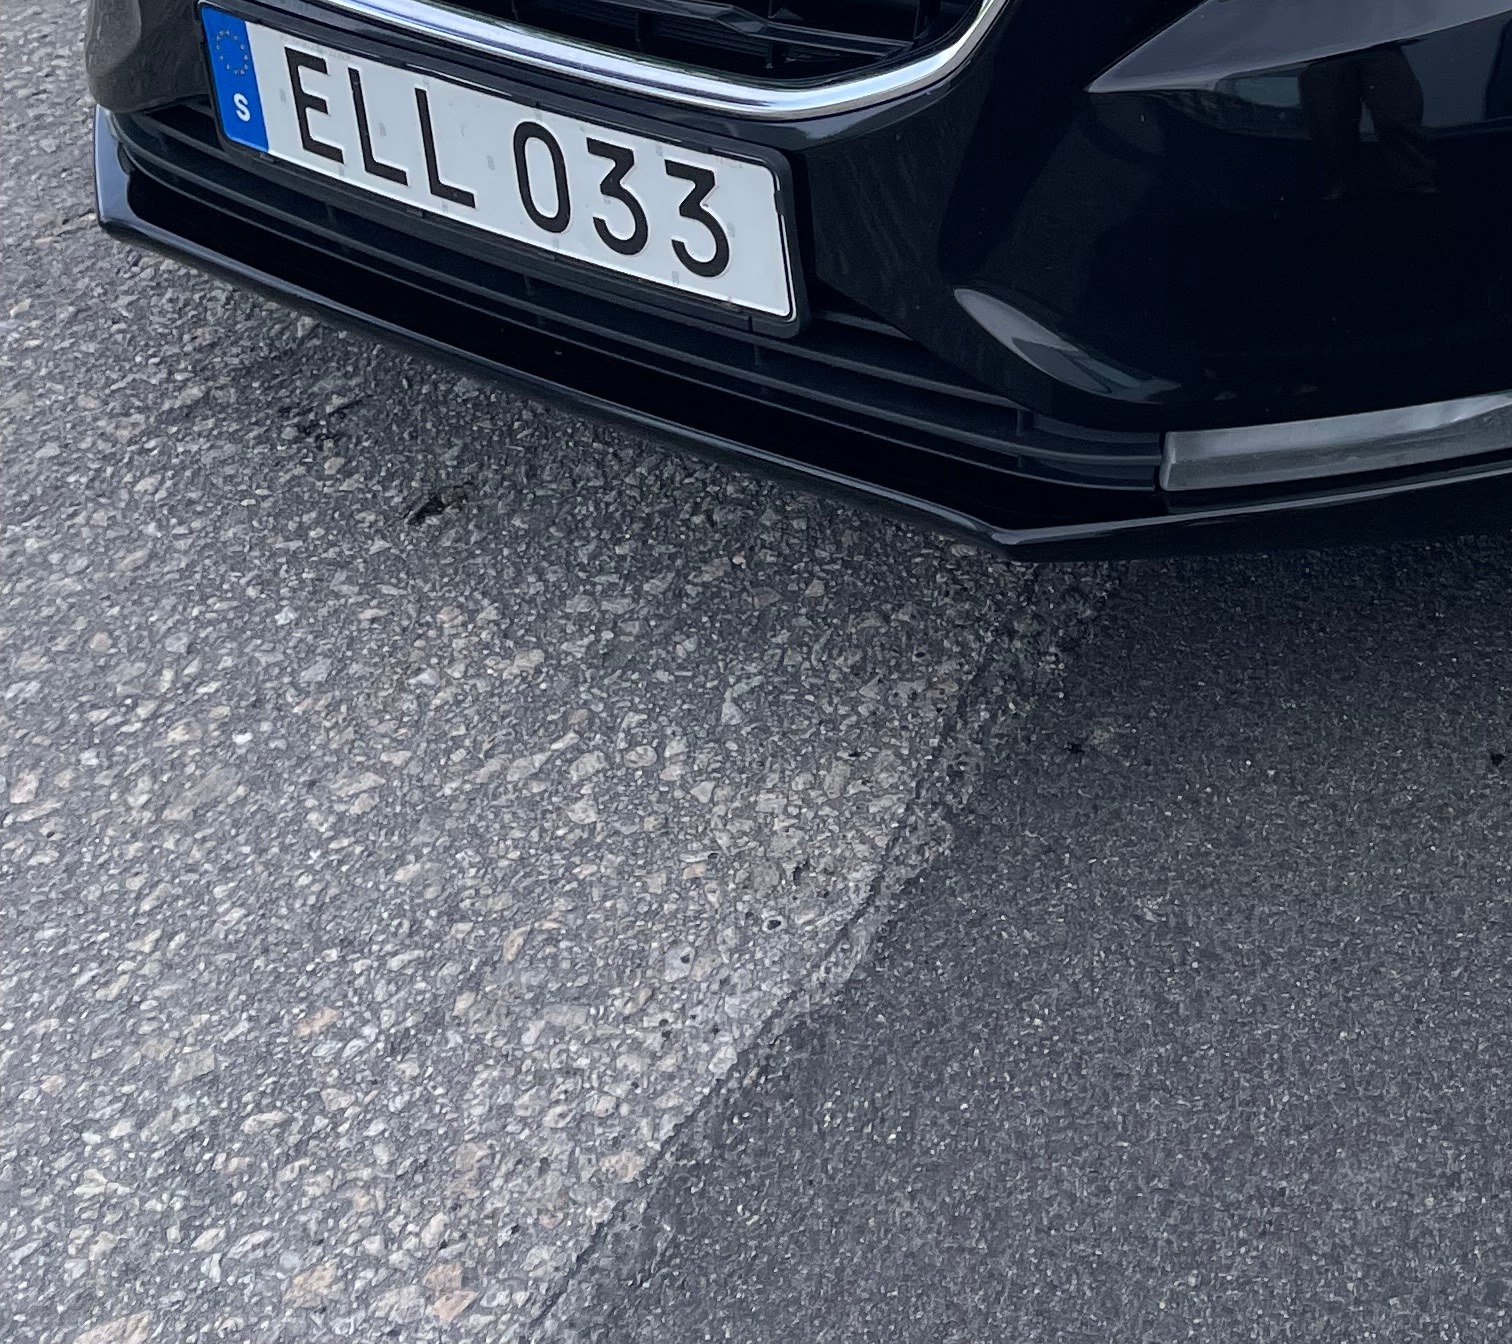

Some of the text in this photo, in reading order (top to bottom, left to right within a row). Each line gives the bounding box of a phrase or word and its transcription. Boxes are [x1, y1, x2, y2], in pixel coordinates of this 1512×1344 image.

[233, 92, 251, 122] S
[284, 45, 730, 279] ELL 033
